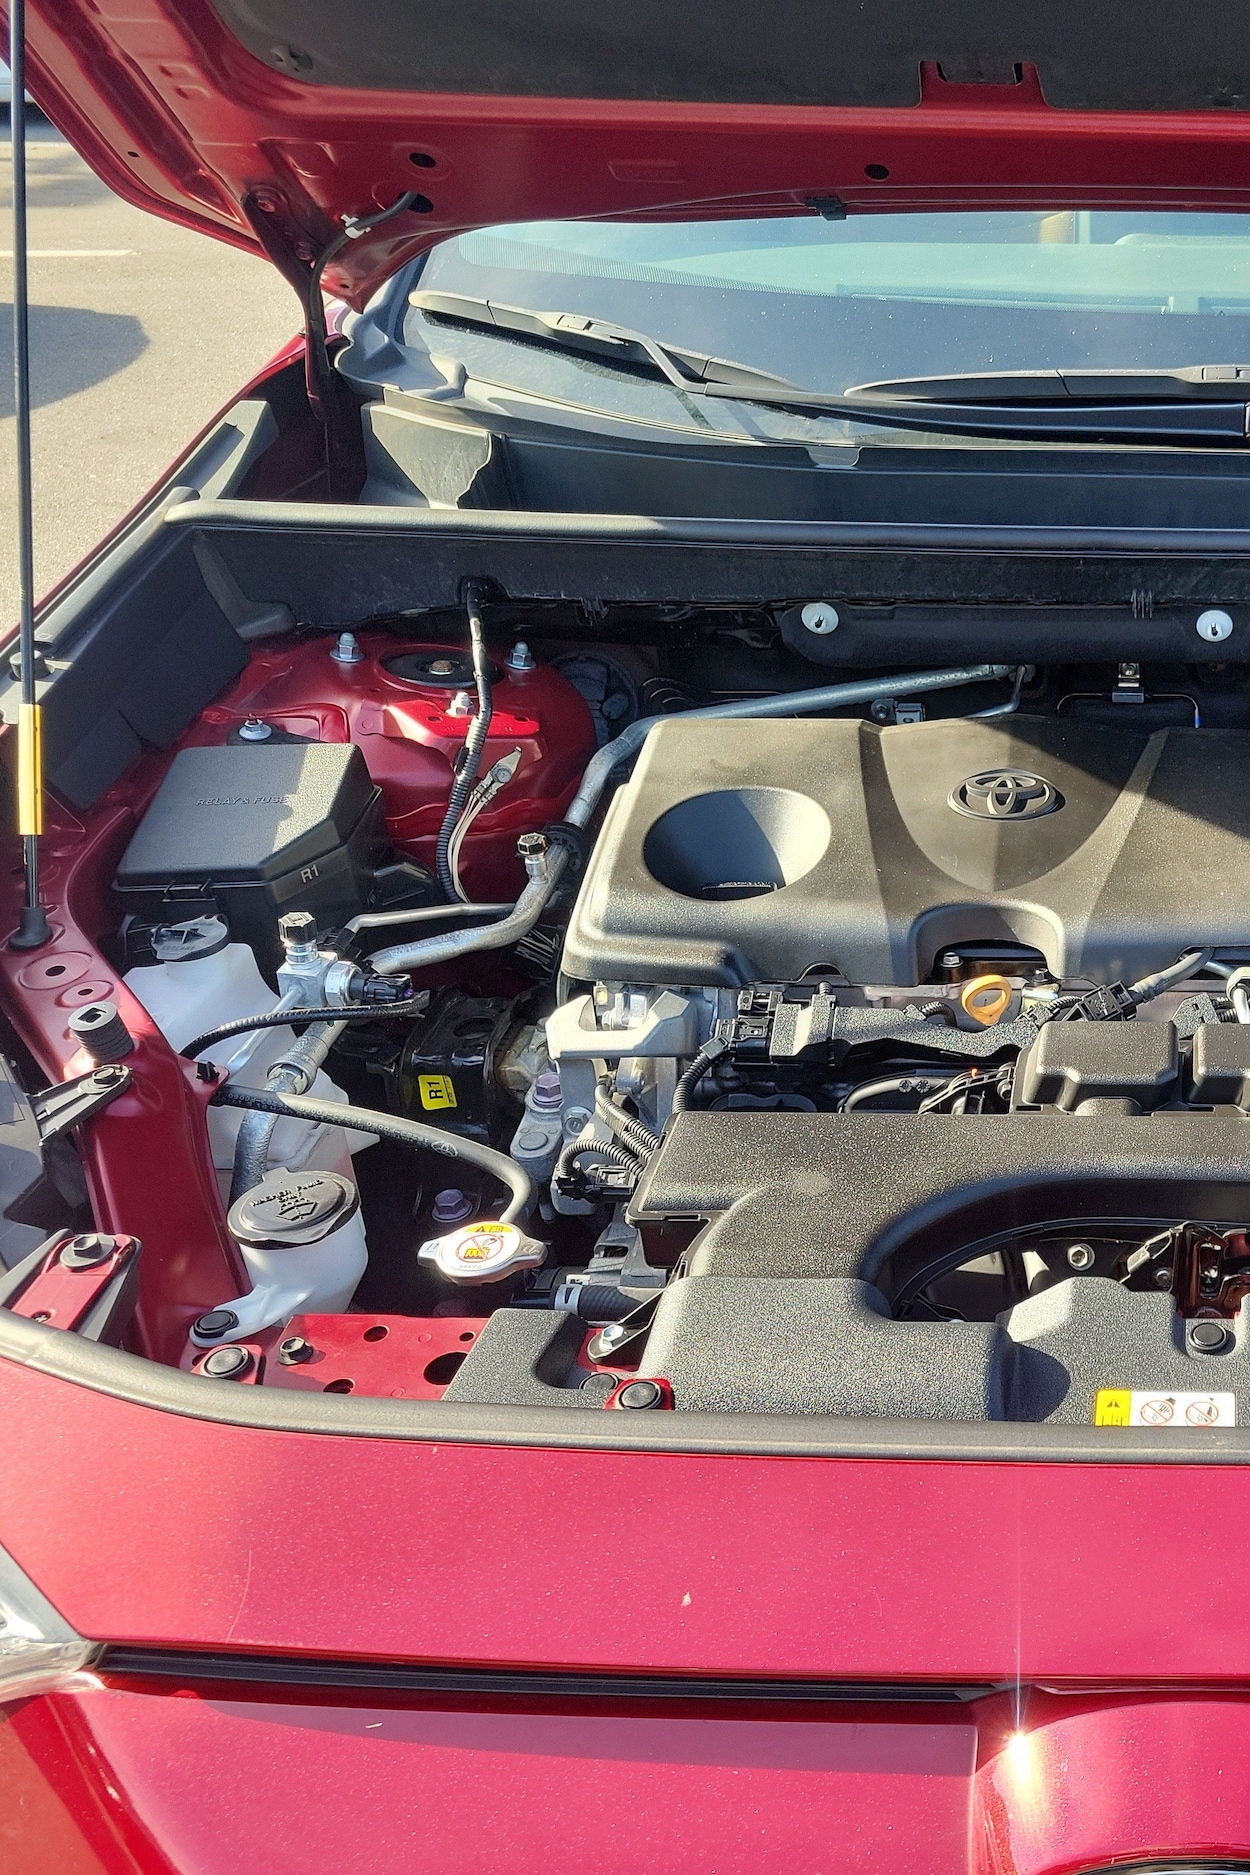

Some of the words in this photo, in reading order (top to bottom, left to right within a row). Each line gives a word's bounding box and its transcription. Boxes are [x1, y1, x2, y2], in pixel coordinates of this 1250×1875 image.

[195, 797, 241, 806] RELAY
[241, 797, 250, 805] &
[253, 796, 289, 804] FUSE
[300, 864, 319, 883] R1
[427, 1081, 444, 1099] R1
[249, 1189, 293, 1207] WASHER
[296, 1180, 324, 1192] FLUID
